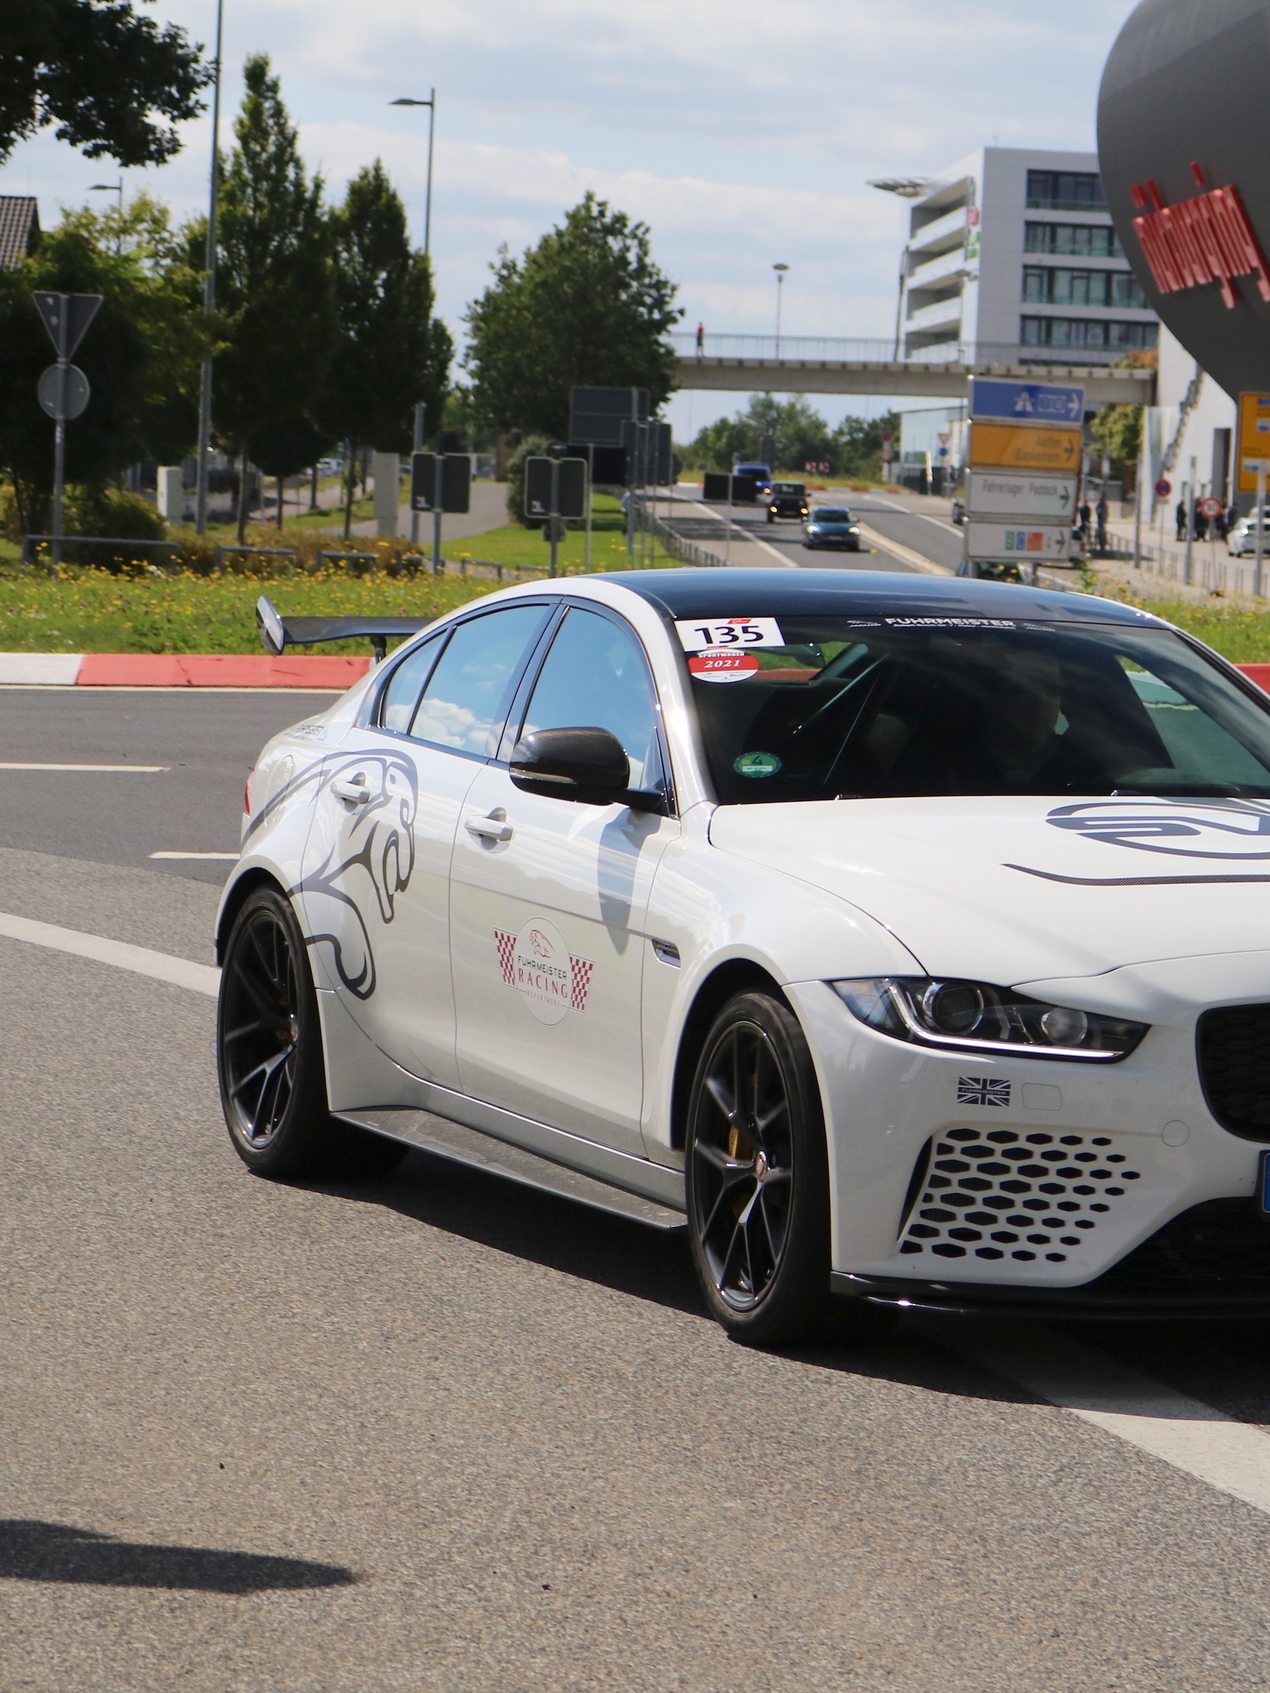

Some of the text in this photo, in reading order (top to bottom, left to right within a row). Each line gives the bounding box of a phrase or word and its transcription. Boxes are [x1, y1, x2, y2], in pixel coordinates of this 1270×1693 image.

[885, 617, 1017, 628] FUHRMEISTER
[694, 625, 764, 644] 135
[704, 659, 741, 669] 2021
[751, 755, 764, 766] 4
[517, 955, 568, 981] FUHRMEISTER
[518, 968, 568, 999] RACING
[526, 989, 561, 1008] DEPARTMENT
